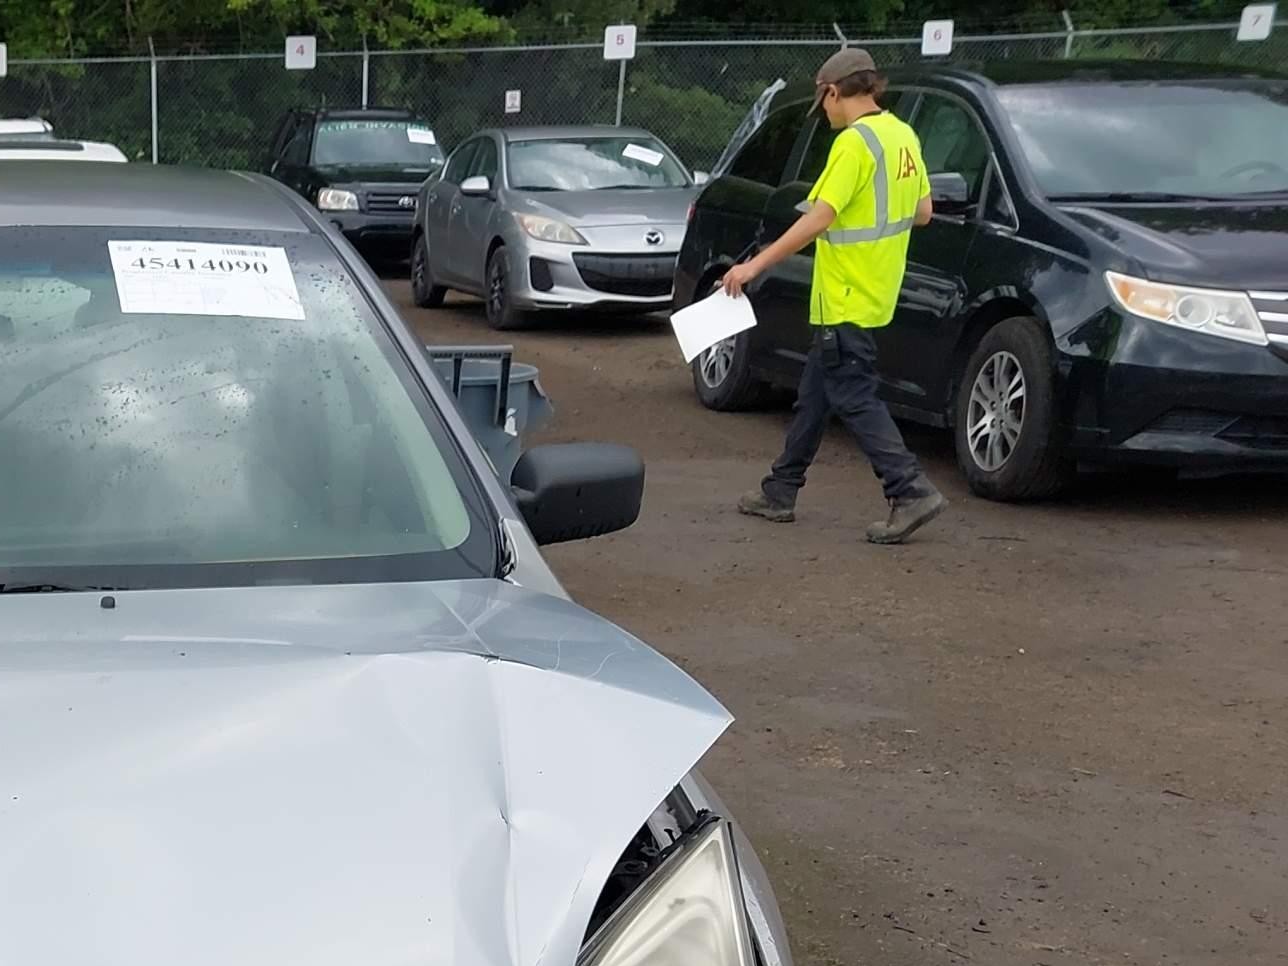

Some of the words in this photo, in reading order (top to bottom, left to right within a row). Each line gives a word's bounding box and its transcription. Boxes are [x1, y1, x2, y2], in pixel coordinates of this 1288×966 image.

[1251, 14, 1262, 27] 7
[616, 34, 625, 46] 5
[933, 29, 942, 40] 6
[295, 44, 305, 56] 4
[130, 257, 269, 275] 45414090
